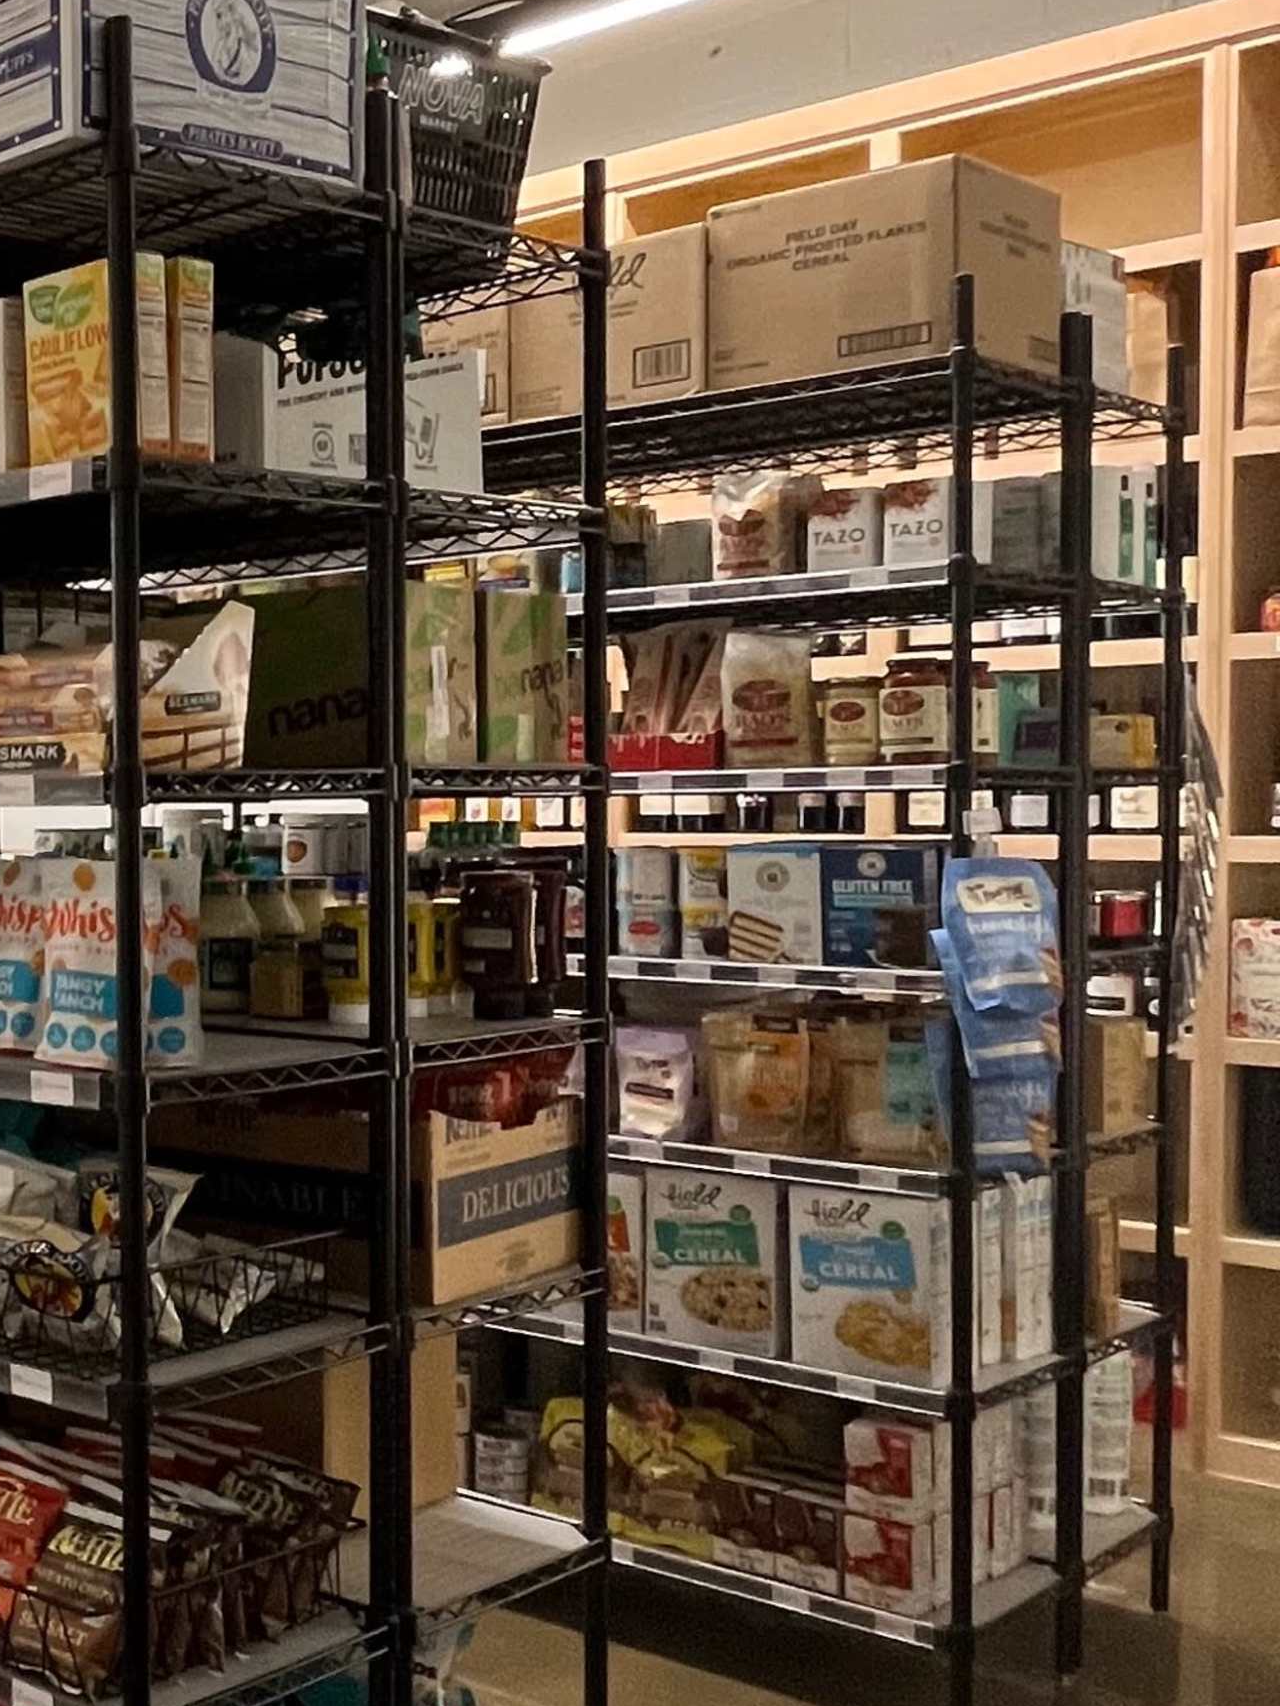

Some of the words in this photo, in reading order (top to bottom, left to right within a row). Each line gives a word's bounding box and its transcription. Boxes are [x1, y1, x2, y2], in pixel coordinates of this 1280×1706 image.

[398, 63, 484, 126] NOVA
[419, 114, 459, 134] MARKET
[791, 251, 851, 271] CEREAL
[812, 527, 866, 544] TAZO
[889, 519, 944, 536] TAZO
[832, 880, 880, 894] GLUTEN
[882, 879, 914, 893] FREE
[462, 1165, 571, 1224] DELICIOUS
[673, 1246, 746, 1264] CEREAL
[819, 1261, 900, 1282] CEREAL
